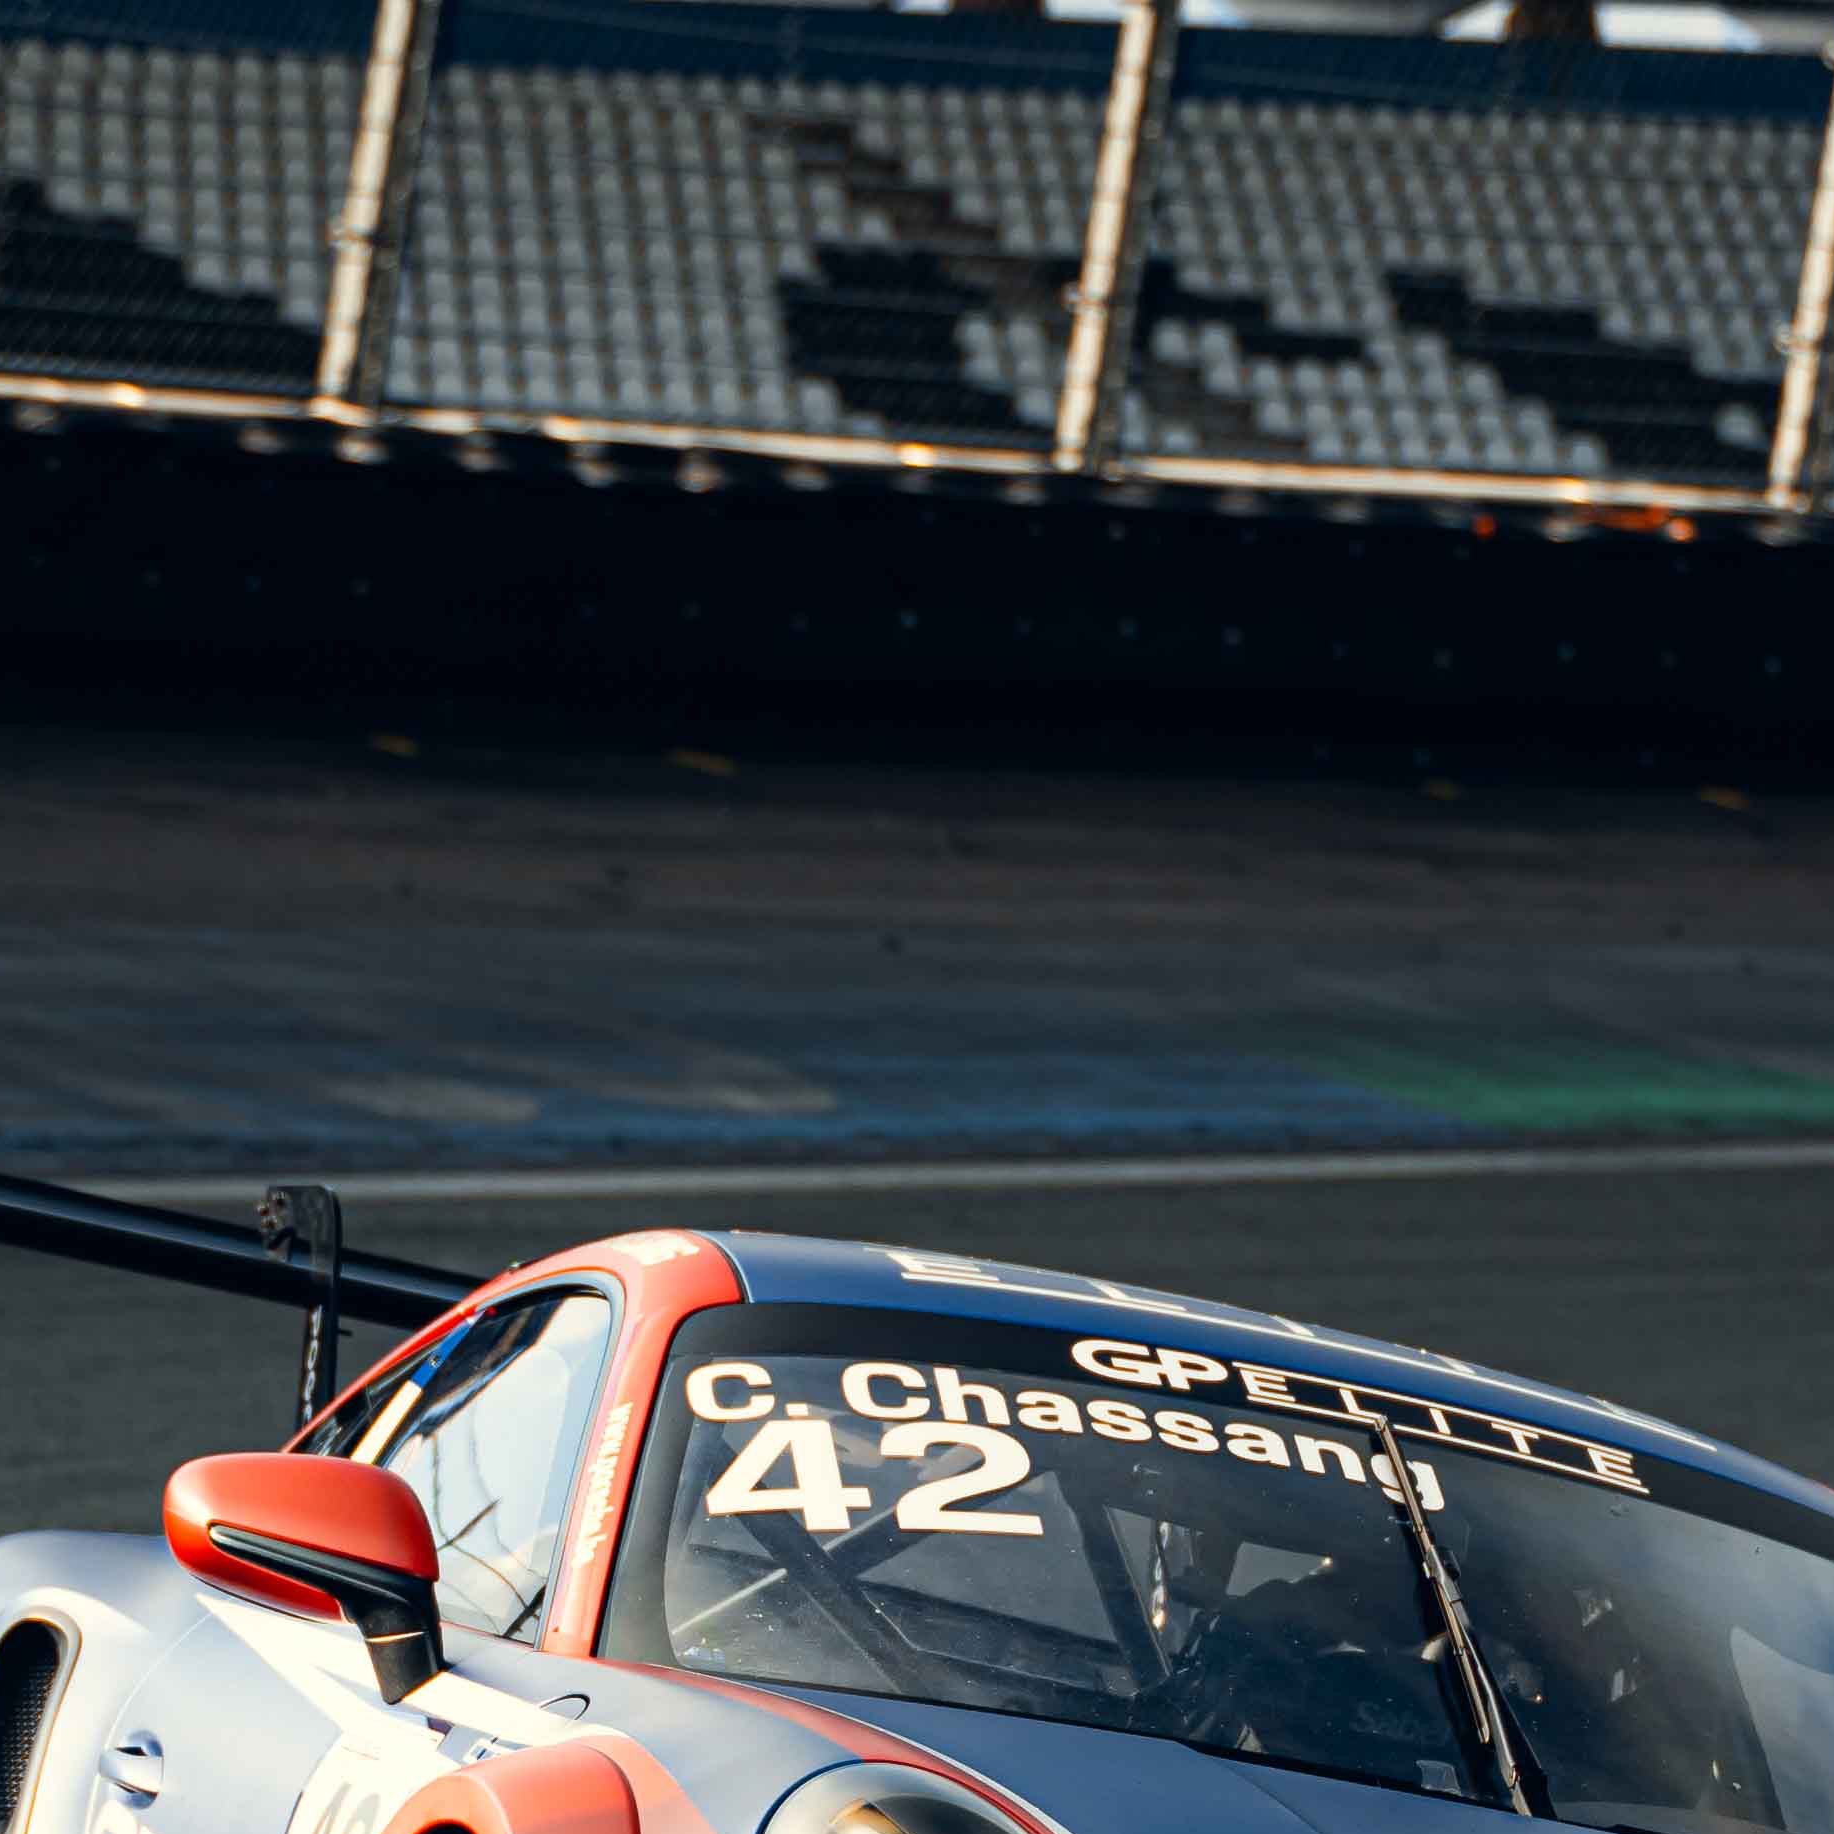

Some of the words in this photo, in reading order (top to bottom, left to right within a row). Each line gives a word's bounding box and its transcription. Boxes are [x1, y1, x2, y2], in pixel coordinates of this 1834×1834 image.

[685, 1361, 808, 1422] C.
[840, 1361, 1445, 1511] Chassang
[706, 1422, 1043, 1536] 42
